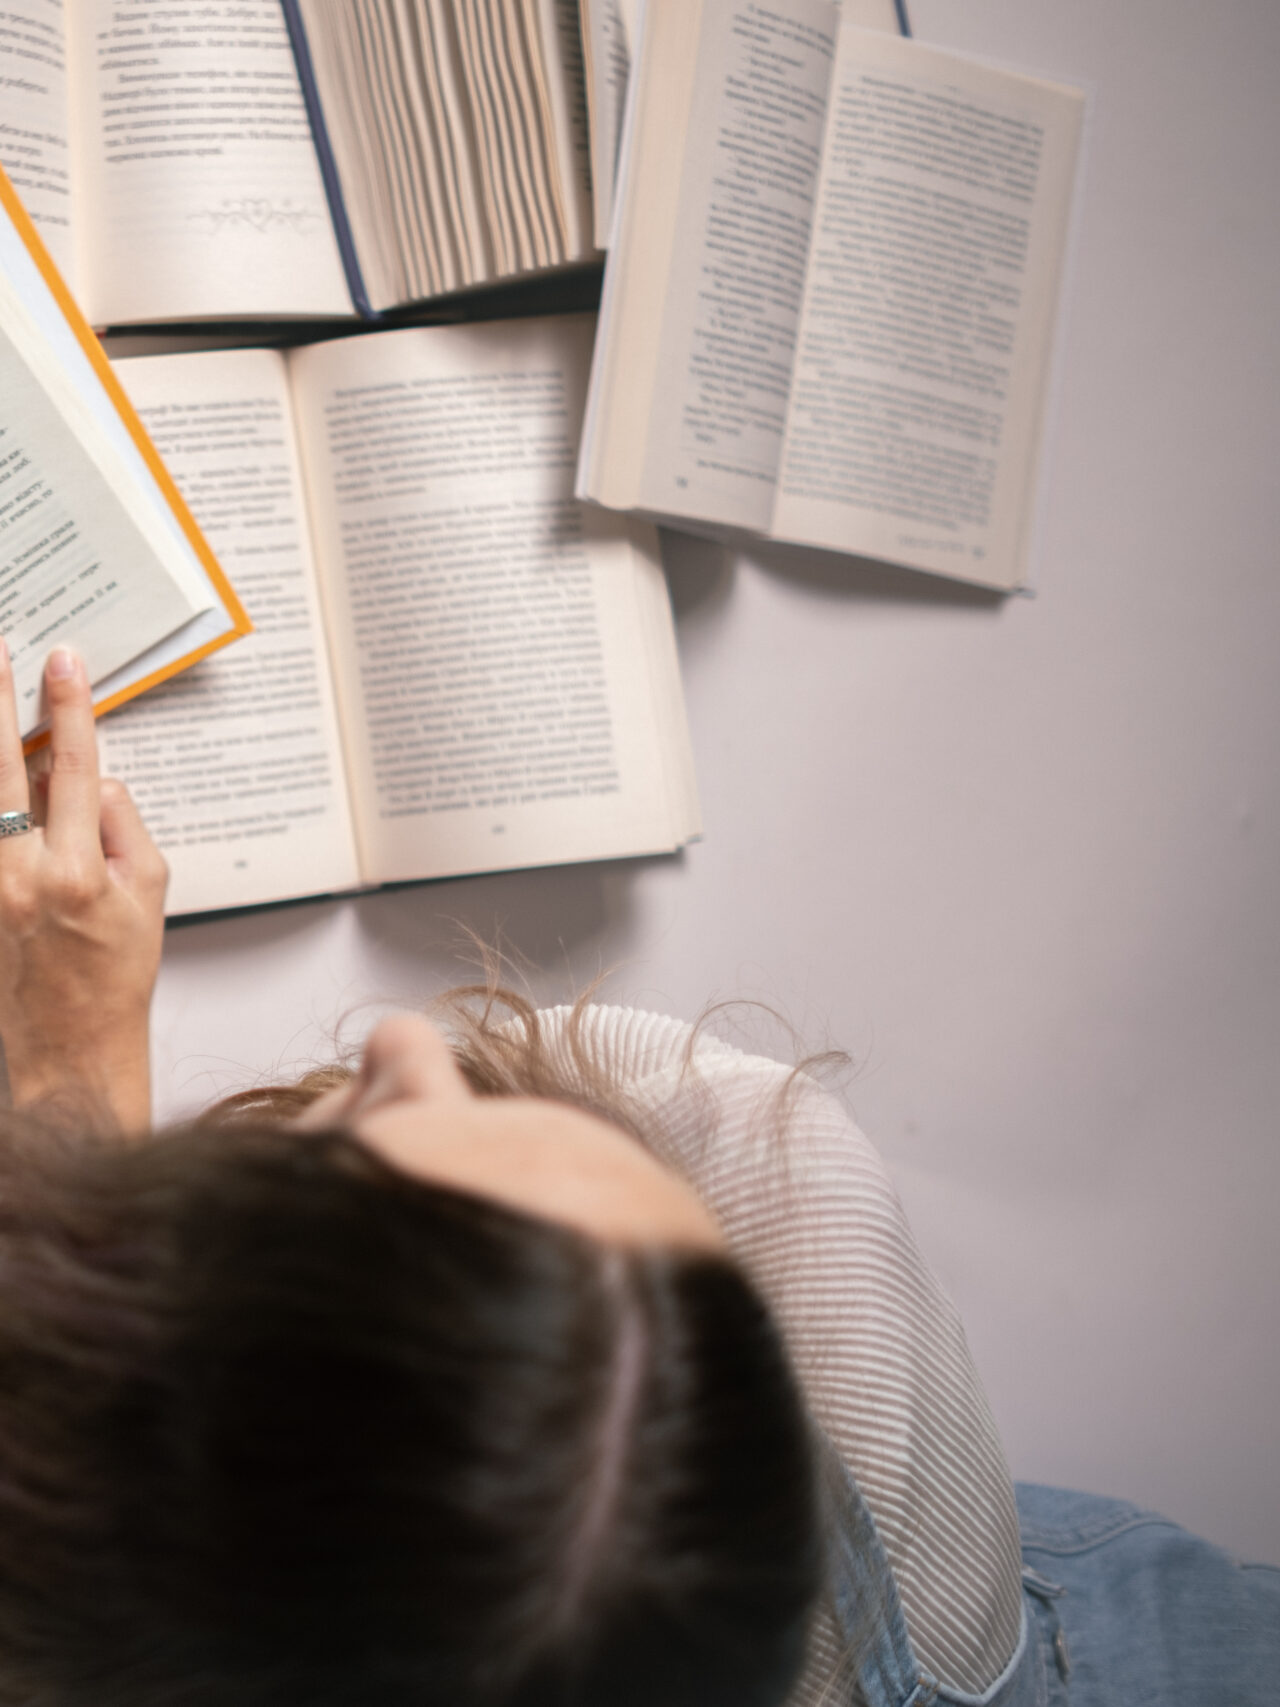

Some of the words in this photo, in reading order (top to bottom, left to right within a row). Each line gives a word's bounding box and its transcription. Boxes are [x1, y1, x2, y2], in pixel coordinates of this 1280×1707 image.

[8, 498, 43, 523] вчасно,
[41, 488, 54, 500] то
[14, 480, 43, 503] відсту-
[12, 537, 51, 565] Усмішка
[49, 519, 75, 540] грала
[28, 614, 69, 646] нарочито
[69, 596, 95, 617] взяла
[104, 580, 118, 592] на
